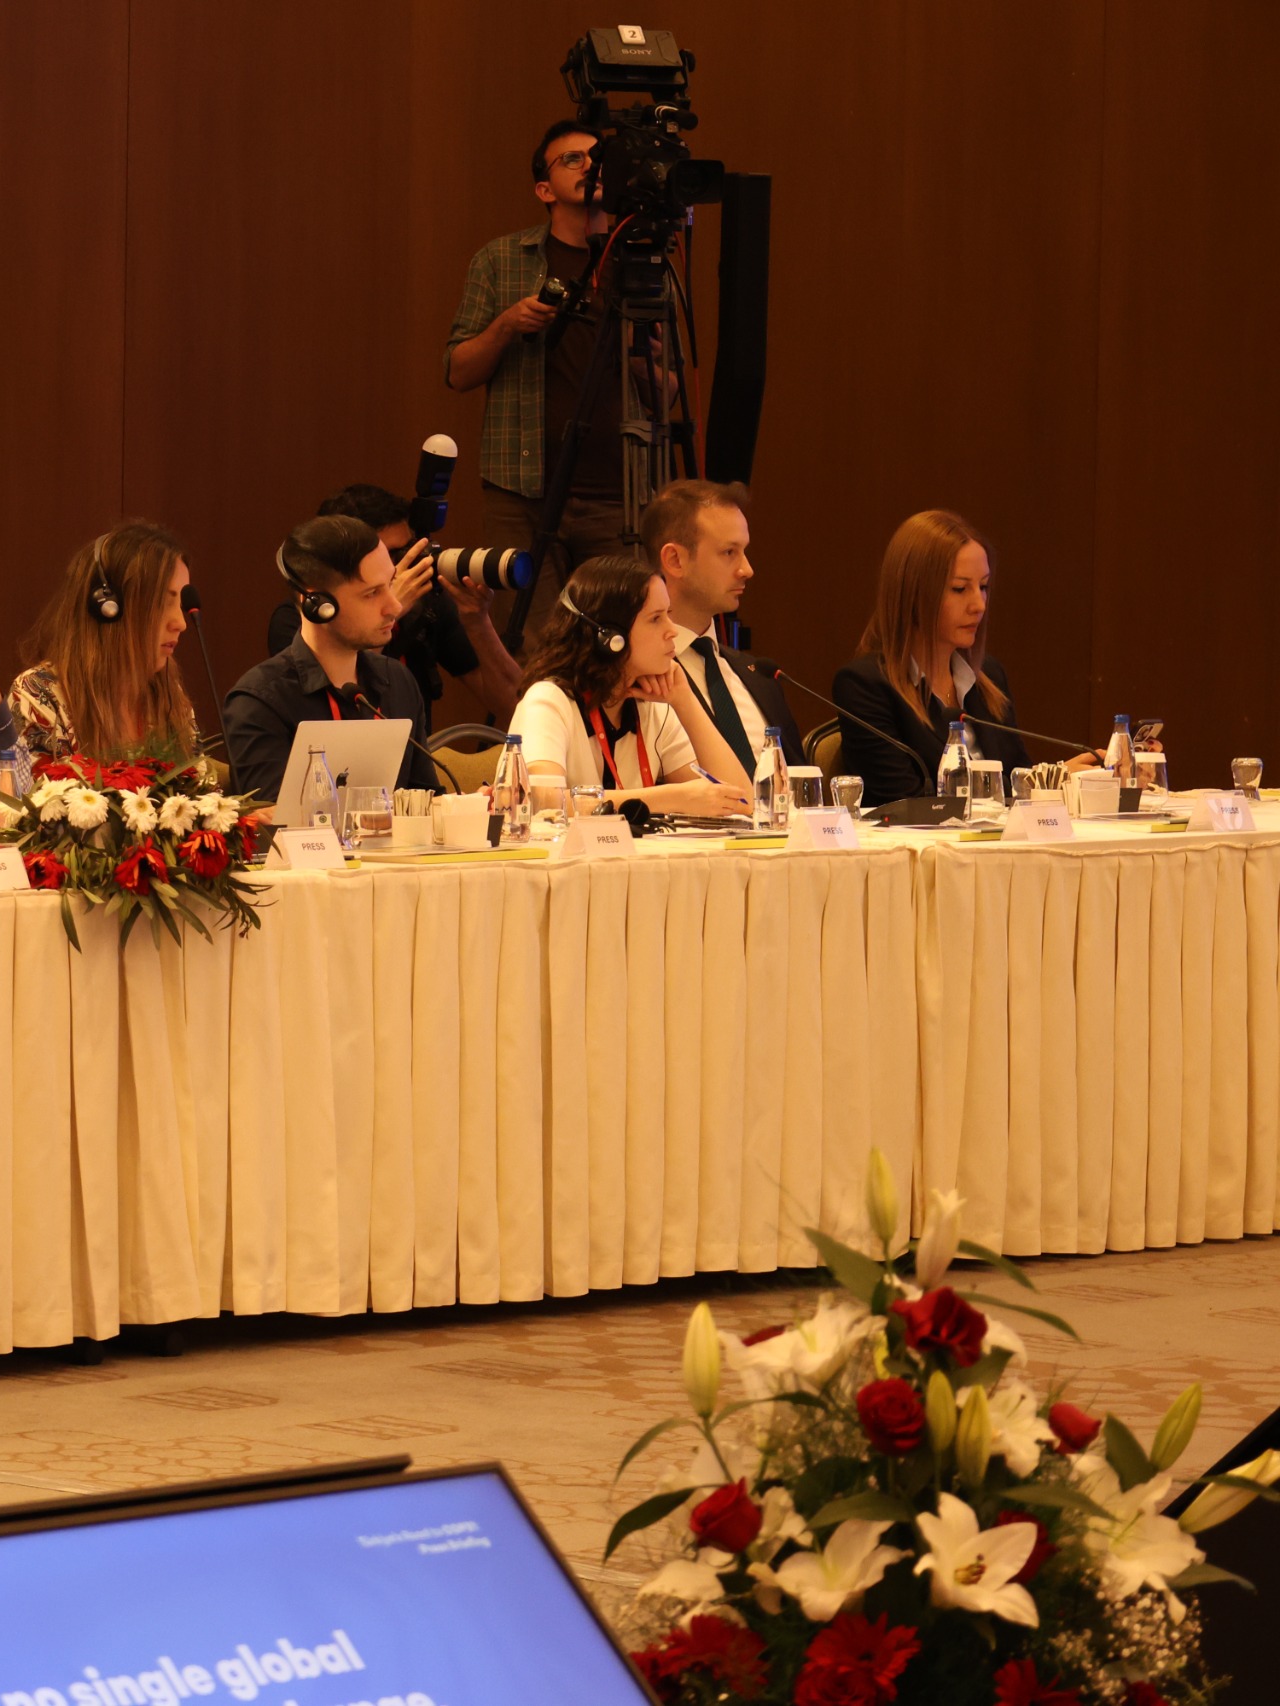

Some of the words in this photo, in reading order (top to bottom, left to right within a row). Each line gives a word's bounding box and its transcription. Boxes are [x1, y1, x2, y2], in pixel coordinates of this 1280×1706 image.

[627, 30, 637, 38] 2
[1037, 818, 1059, 826] PRESS
[597, 835, 619, 844] PRESS
[301, 842, 326, 851] PRESS
[68, 1656, 216, 1706] single
[215, 1629, 366, 1701] global
